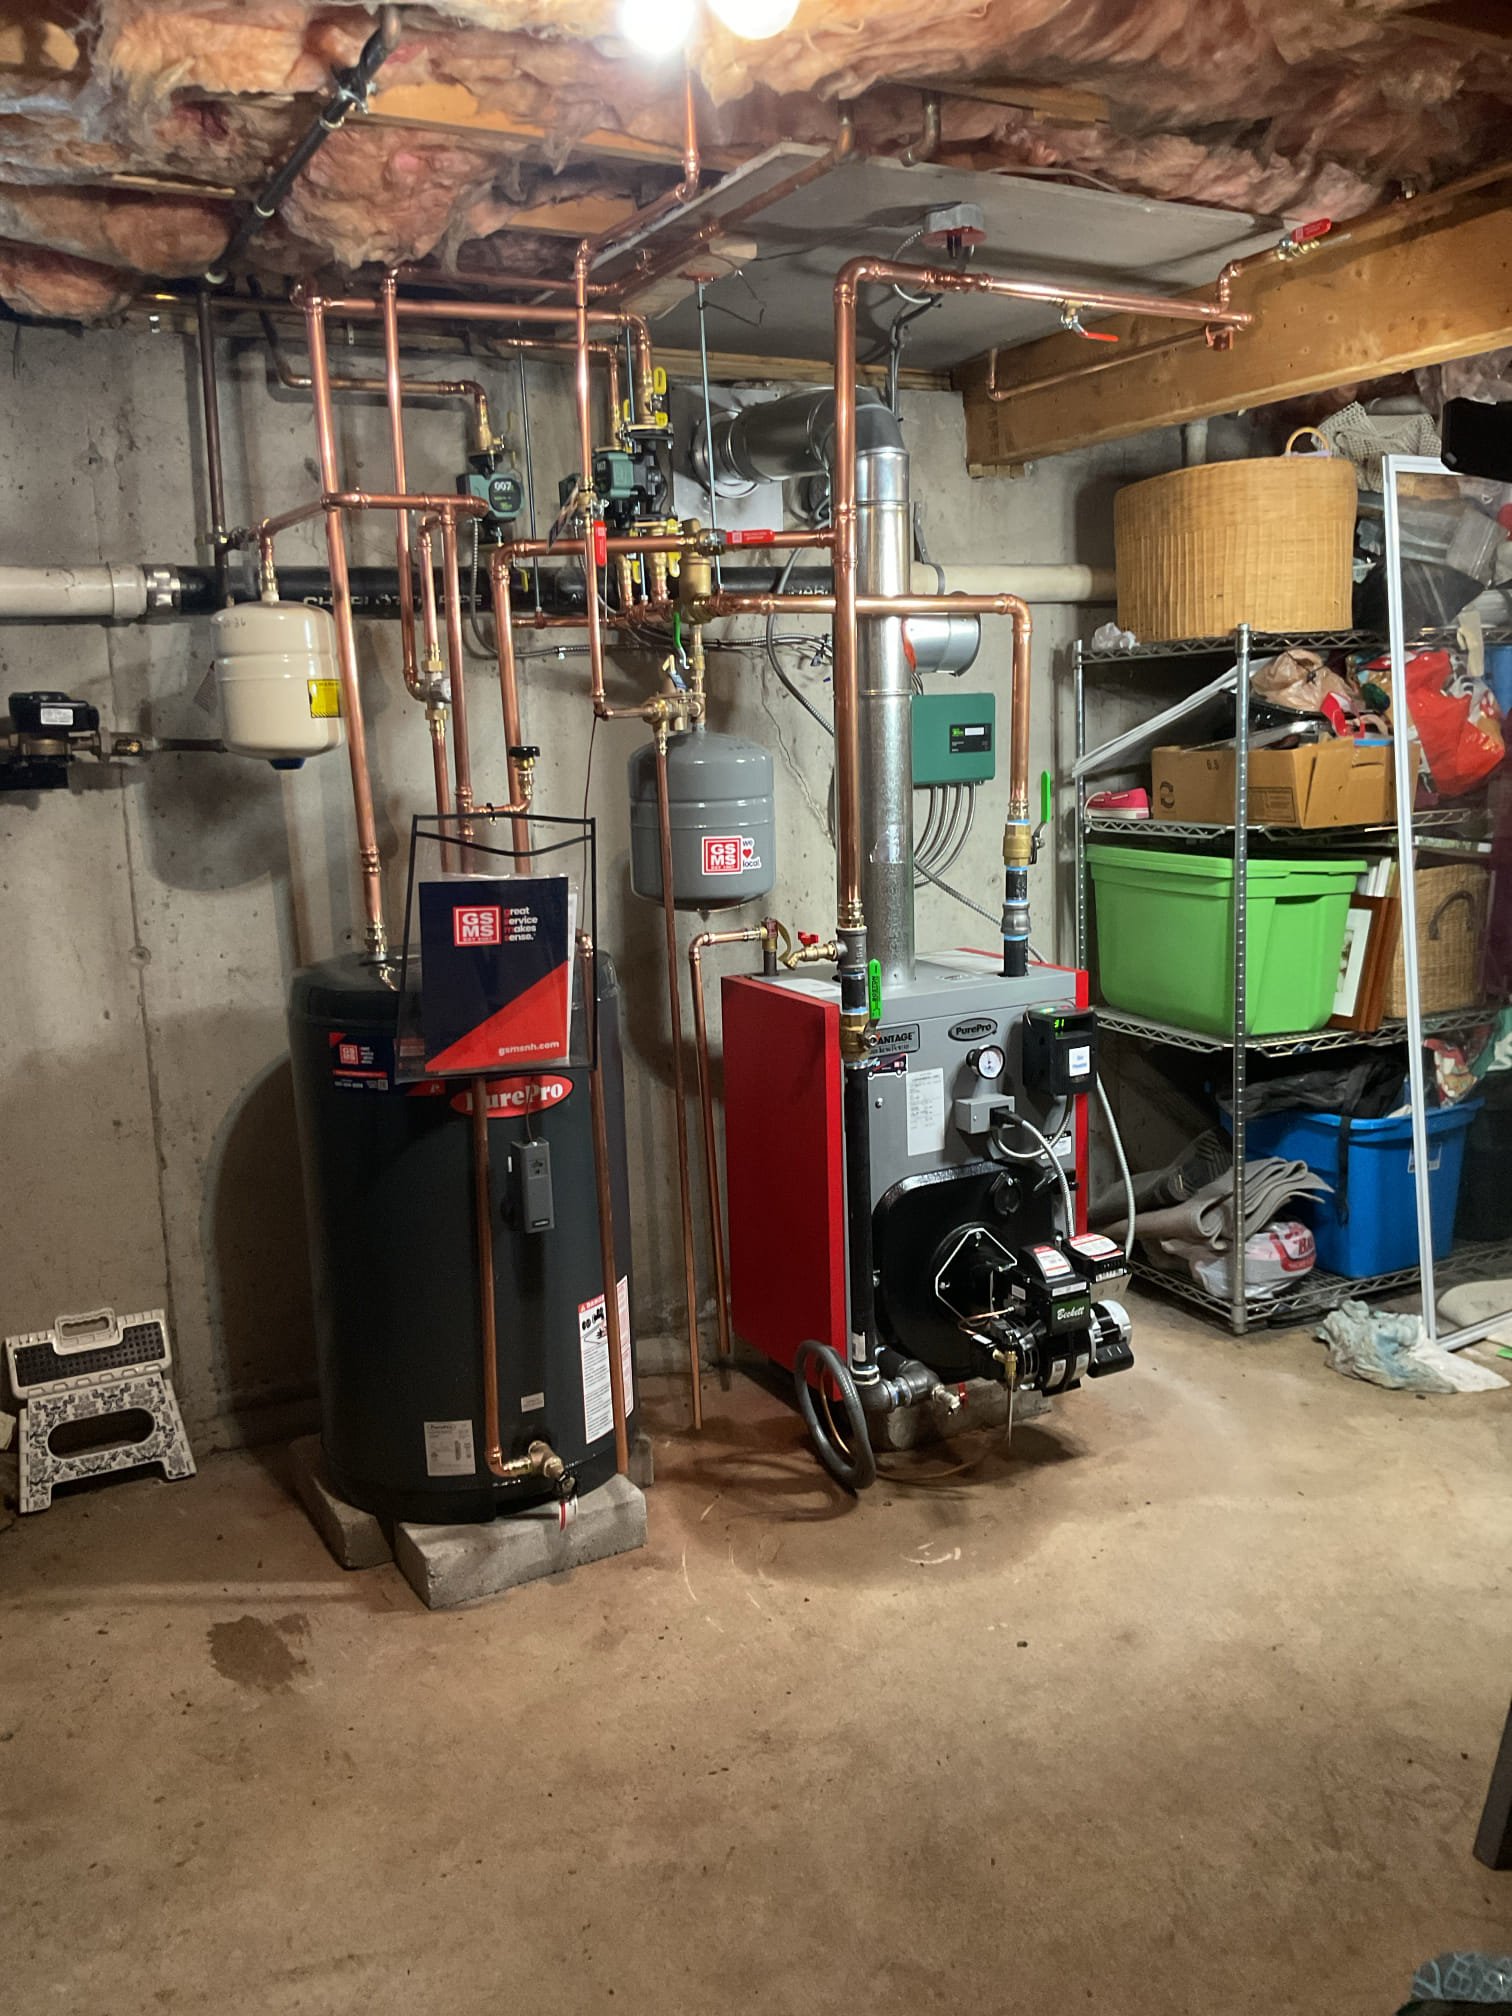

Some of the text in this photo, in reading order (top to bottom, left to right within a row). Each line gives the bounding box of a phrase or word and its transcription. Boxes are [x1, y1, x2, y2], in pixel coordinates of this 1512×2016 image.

[711, 843, 736, 855] GS
[711, 854, 736, 866] MS
[462, 912, 494, 925] GS
[504, 906, 530, 919] great
[504, 916, 538, 926] service
[462, 925, 494, 938] MS
[504, 925, 536, 935] makes
[956, 1023, 992, 1036] PurePro
[878, 1032, 913, 1045] ANTAGE
[498, 1040, 560, 1057] gsmsnh.com
[1057, 1306, 1085, 1321] Beckett
